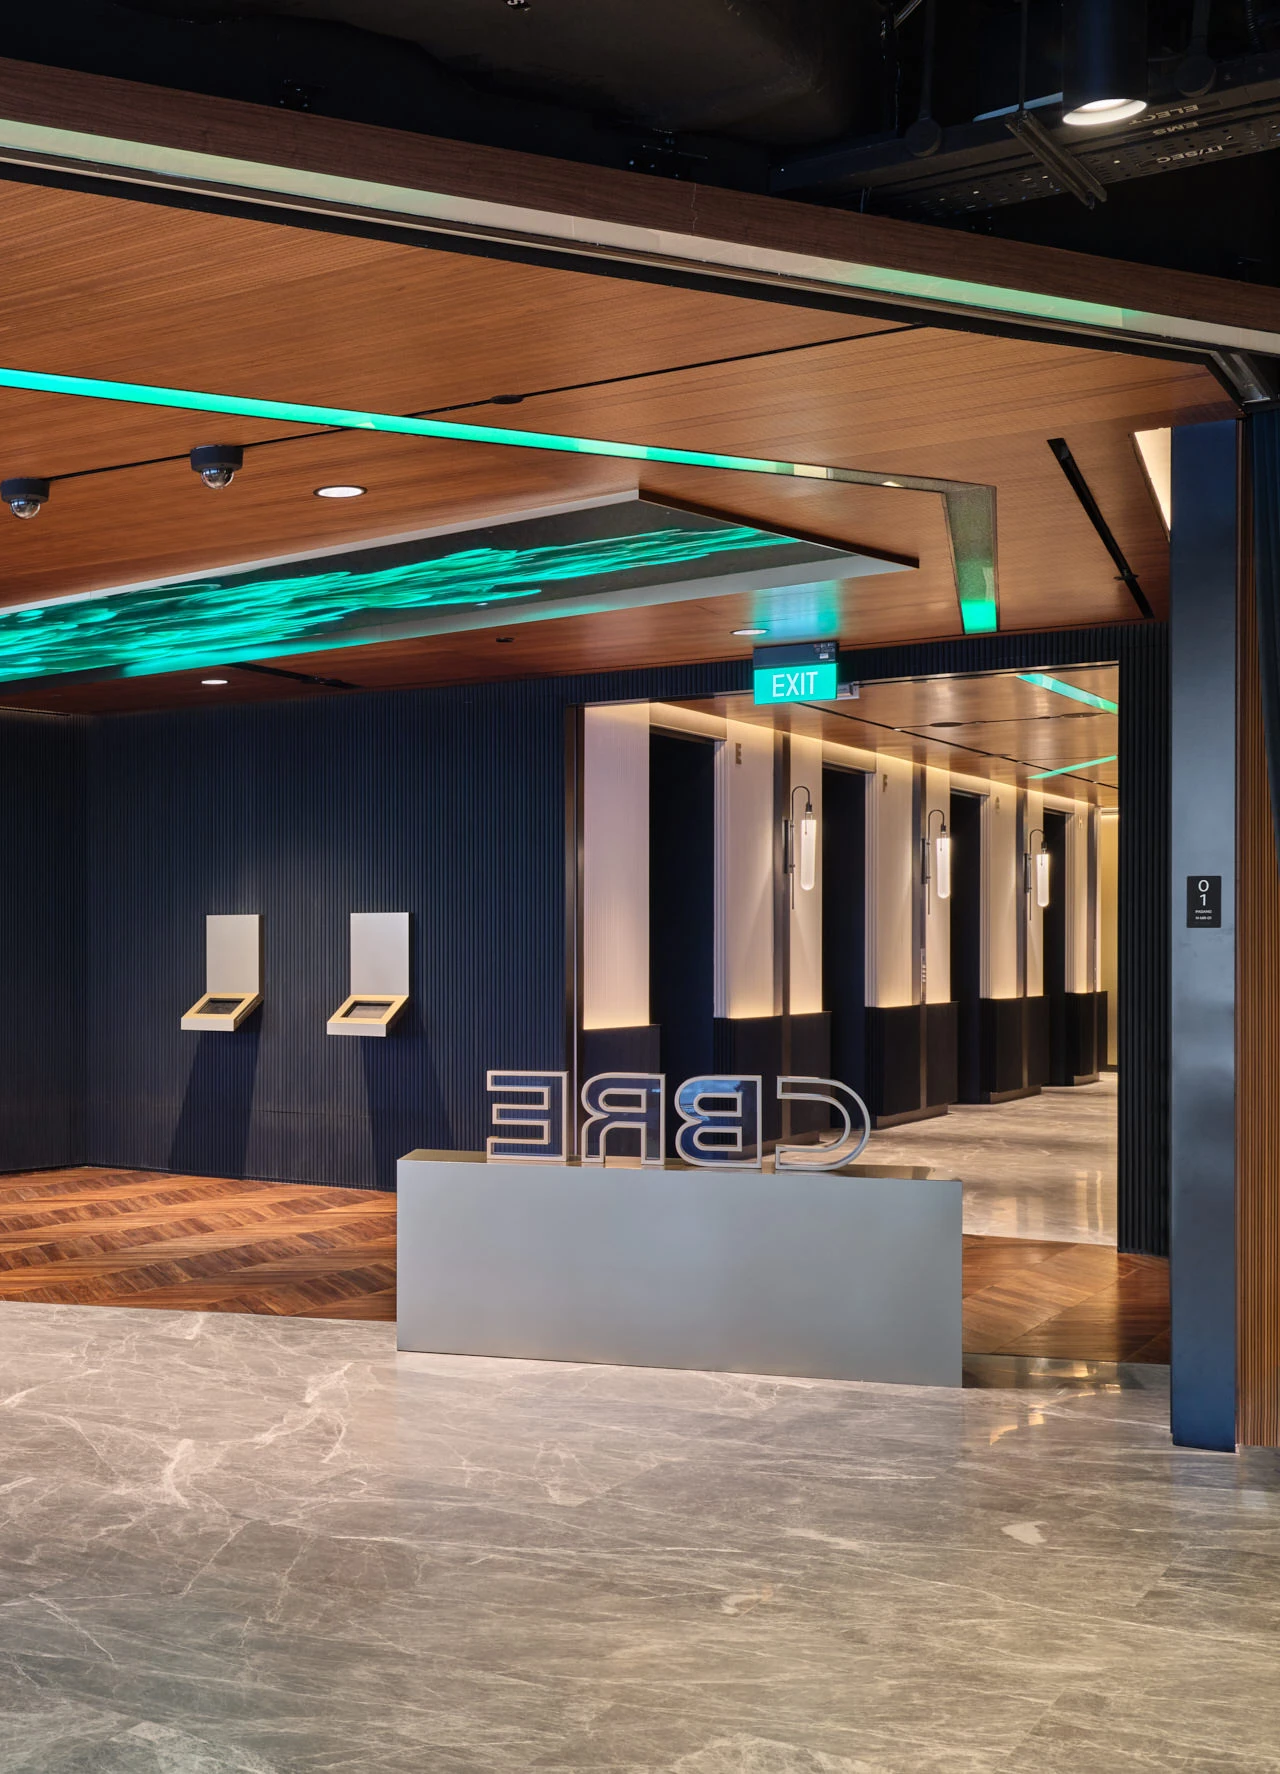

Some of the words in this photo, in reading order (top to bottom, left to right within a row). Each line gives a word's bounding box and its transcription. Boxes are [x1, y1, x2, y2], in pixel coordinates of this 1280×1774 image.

[1128, 104, 1200, 126] ELECT
[1152, 120, 1200, 136] EMS
[1155, 144, 1224, 164] IT/SEC
[771, 671, 819, 698] EXIT
